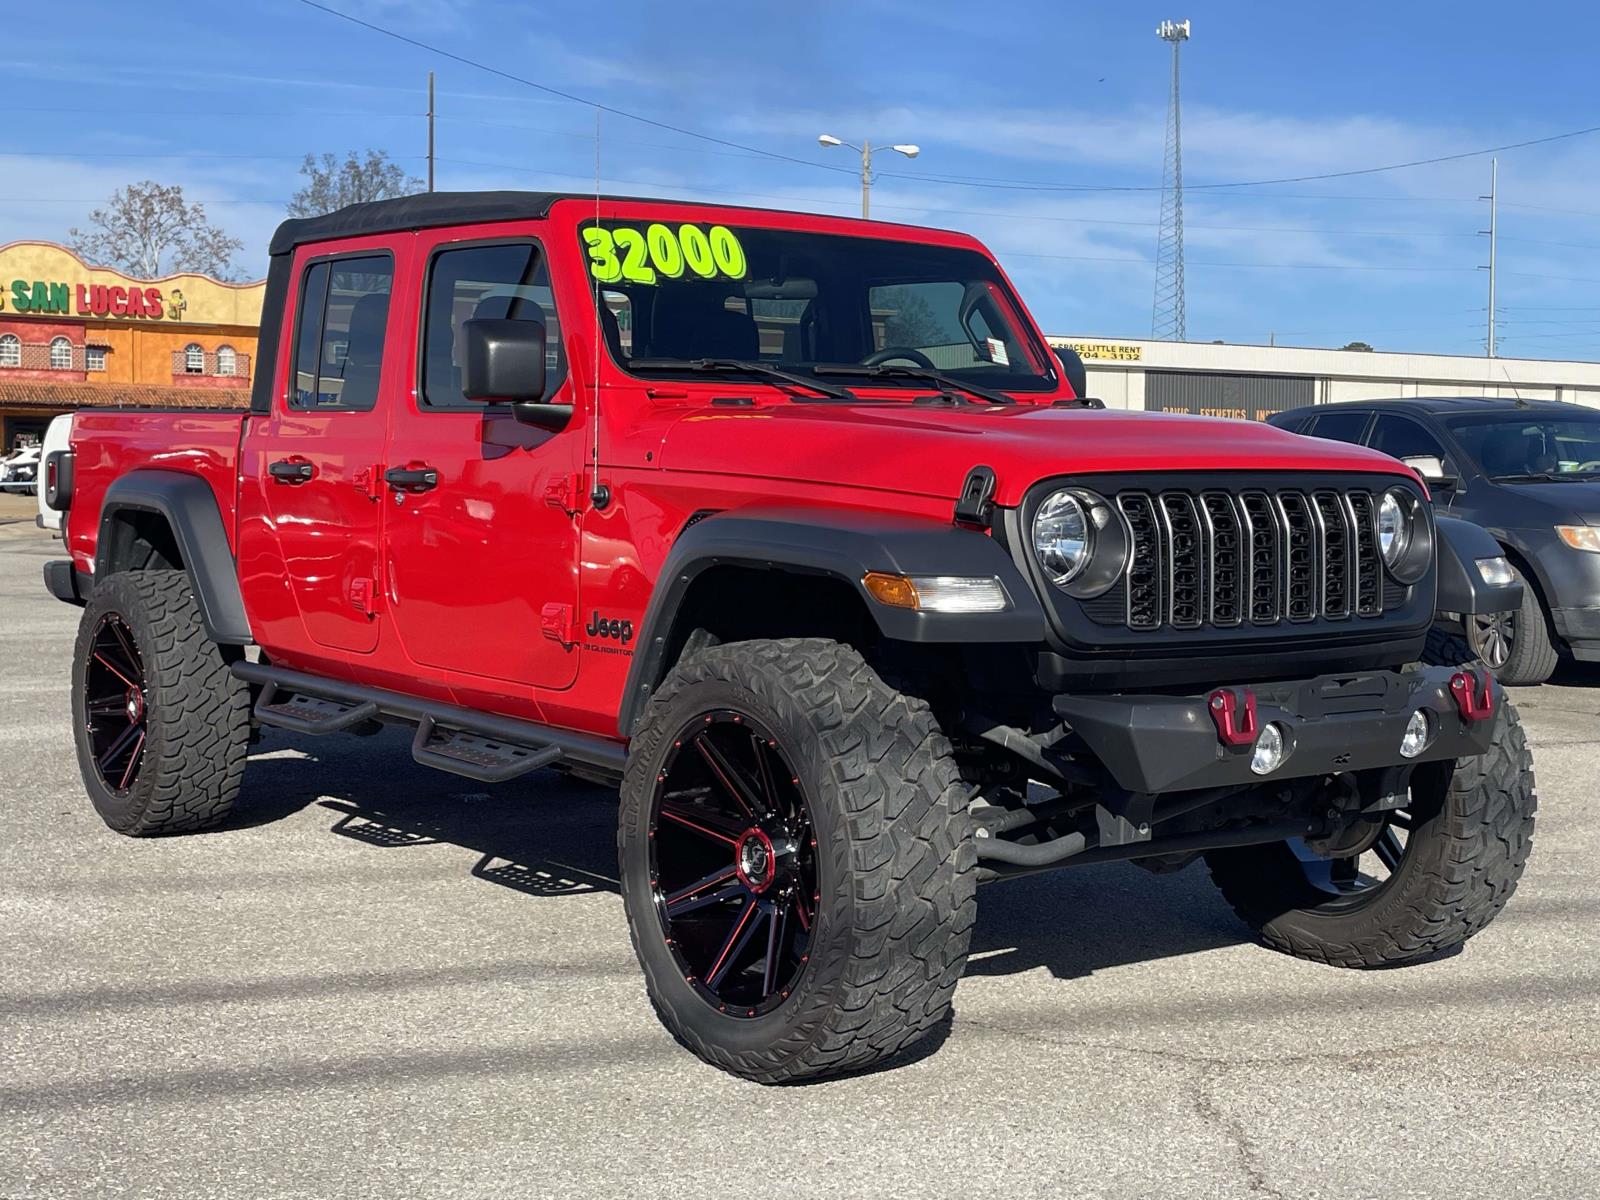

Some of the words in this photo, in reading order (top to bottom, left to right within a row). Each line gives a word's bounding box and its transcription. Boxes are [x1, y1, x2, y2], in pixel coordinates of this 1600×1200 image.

[582, 223, 747, 285] 32000
[11, 279, 69, 314] SAN
[76, 284, 164, 319] LUCAS
[1058, 343, 1085, 351] SPACE
[1087, 344, 1116, 353] LITTLE
[1200, 408, 1247, 420] ESTHETICS
[586, 610, 633, 645] Jeep
